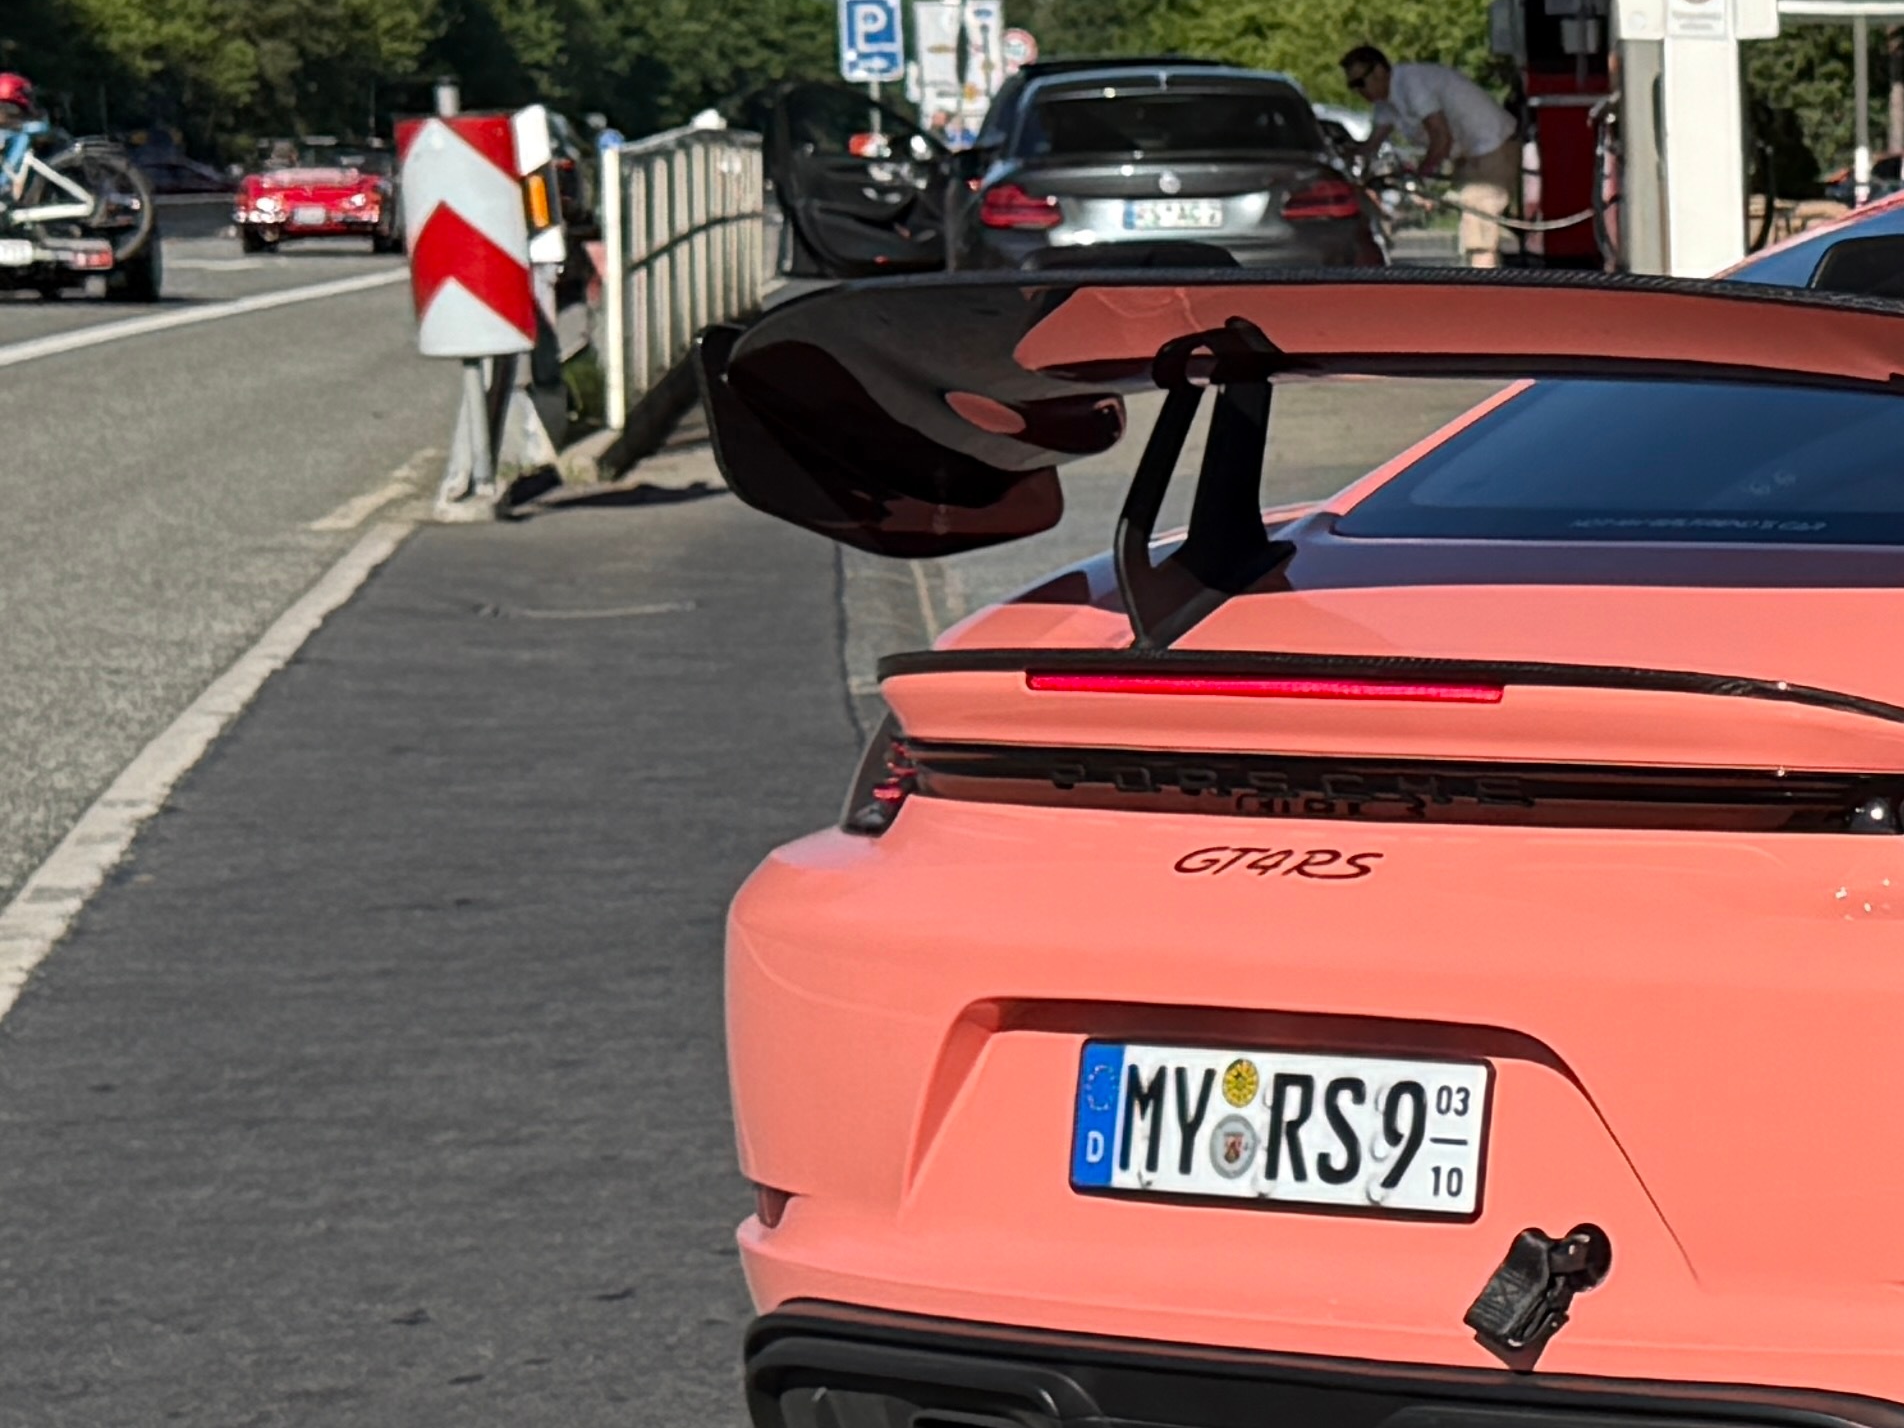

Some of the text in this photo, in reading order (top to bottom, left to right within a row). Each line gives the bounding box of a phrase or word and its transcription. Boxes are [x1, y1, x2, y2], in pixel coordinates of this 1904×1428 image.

[854, 4, 888, 51] P
[1086, 1130, 1105, 1164] D
[1119, 1063, 1217, 1174] MY
[1436, 1085, 1471, 1117] 03
[1431, 1166, 1464, 1198] 10
